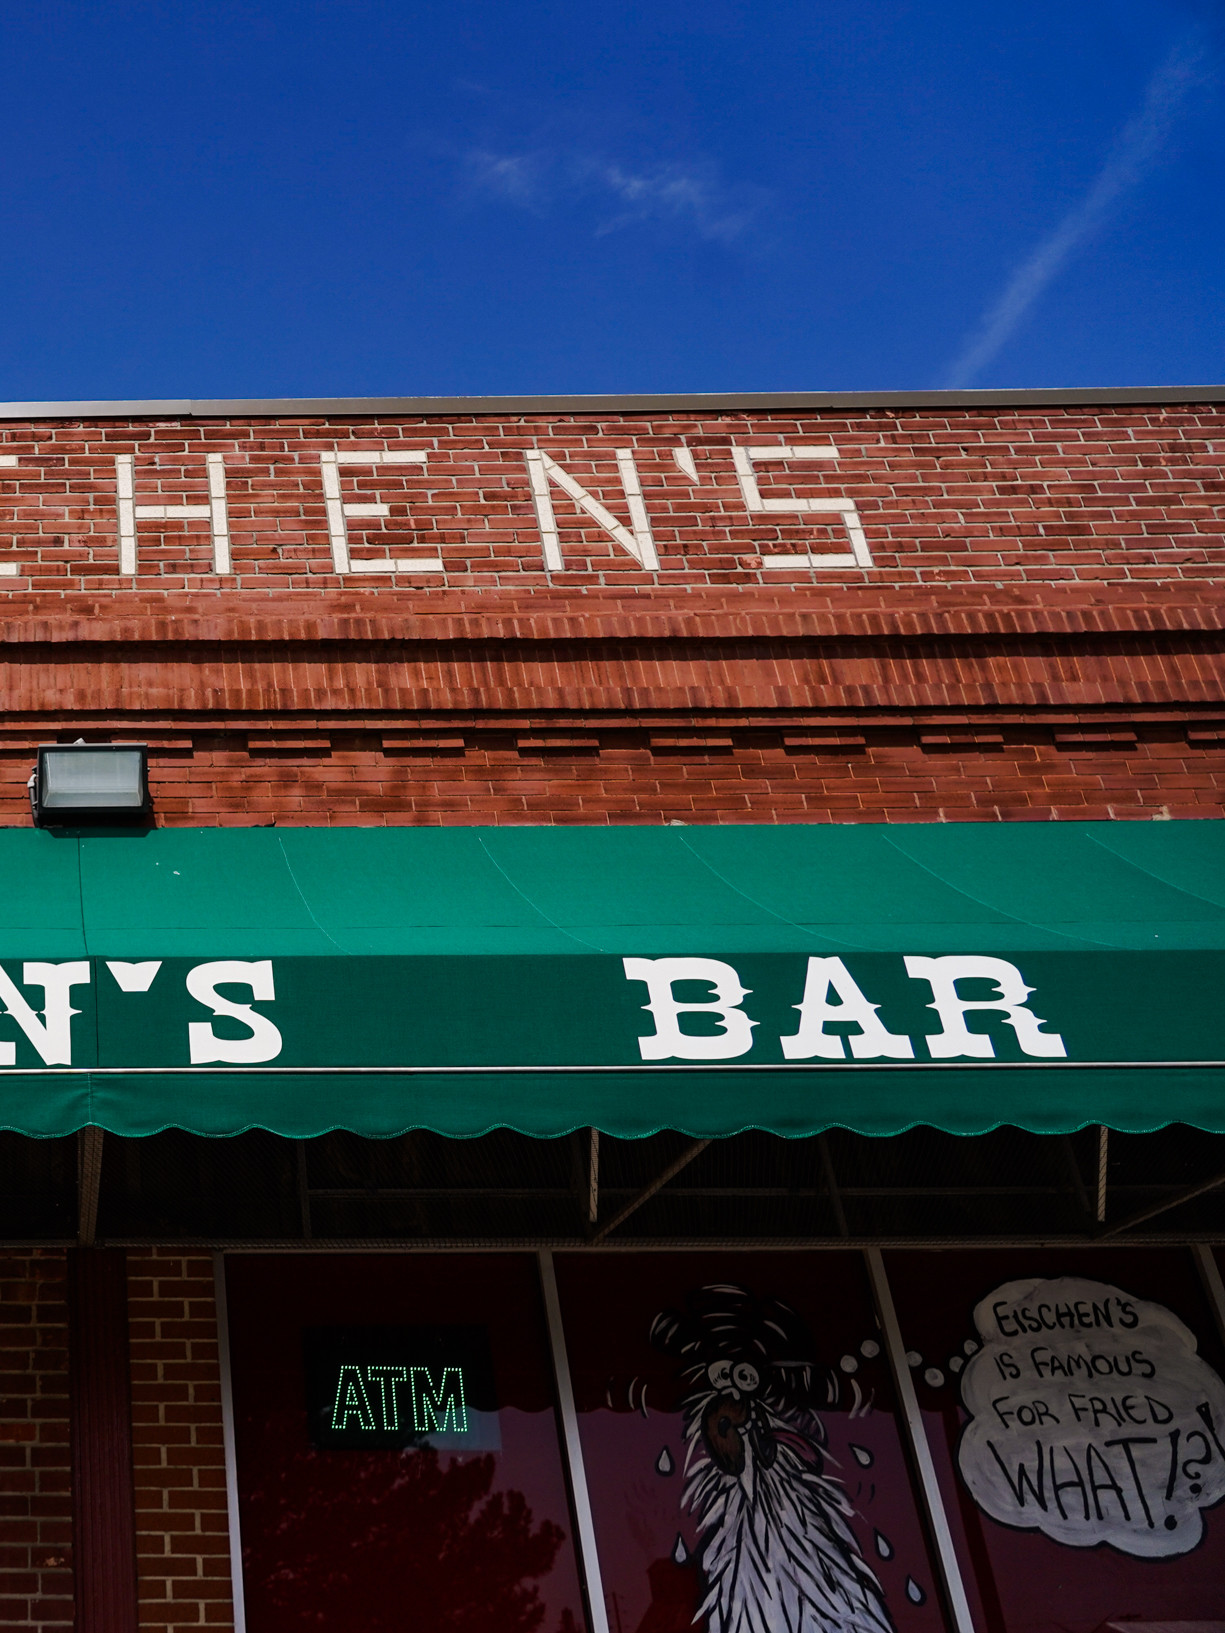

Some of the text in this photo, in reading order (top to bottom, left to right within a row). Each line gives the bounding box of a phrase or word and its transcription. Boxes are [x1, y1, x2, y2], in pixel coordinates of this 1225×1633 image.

[622, 955, 1068, 1061] BAR
[992, 1298, 1139, 1336] EISCHEN'S
[994, 1347, 1156, 1380] IS FAMOUS
[331, 1365, 468, 1432] ATM
[992, 1394, 1174, 1428] FOR FRIED
